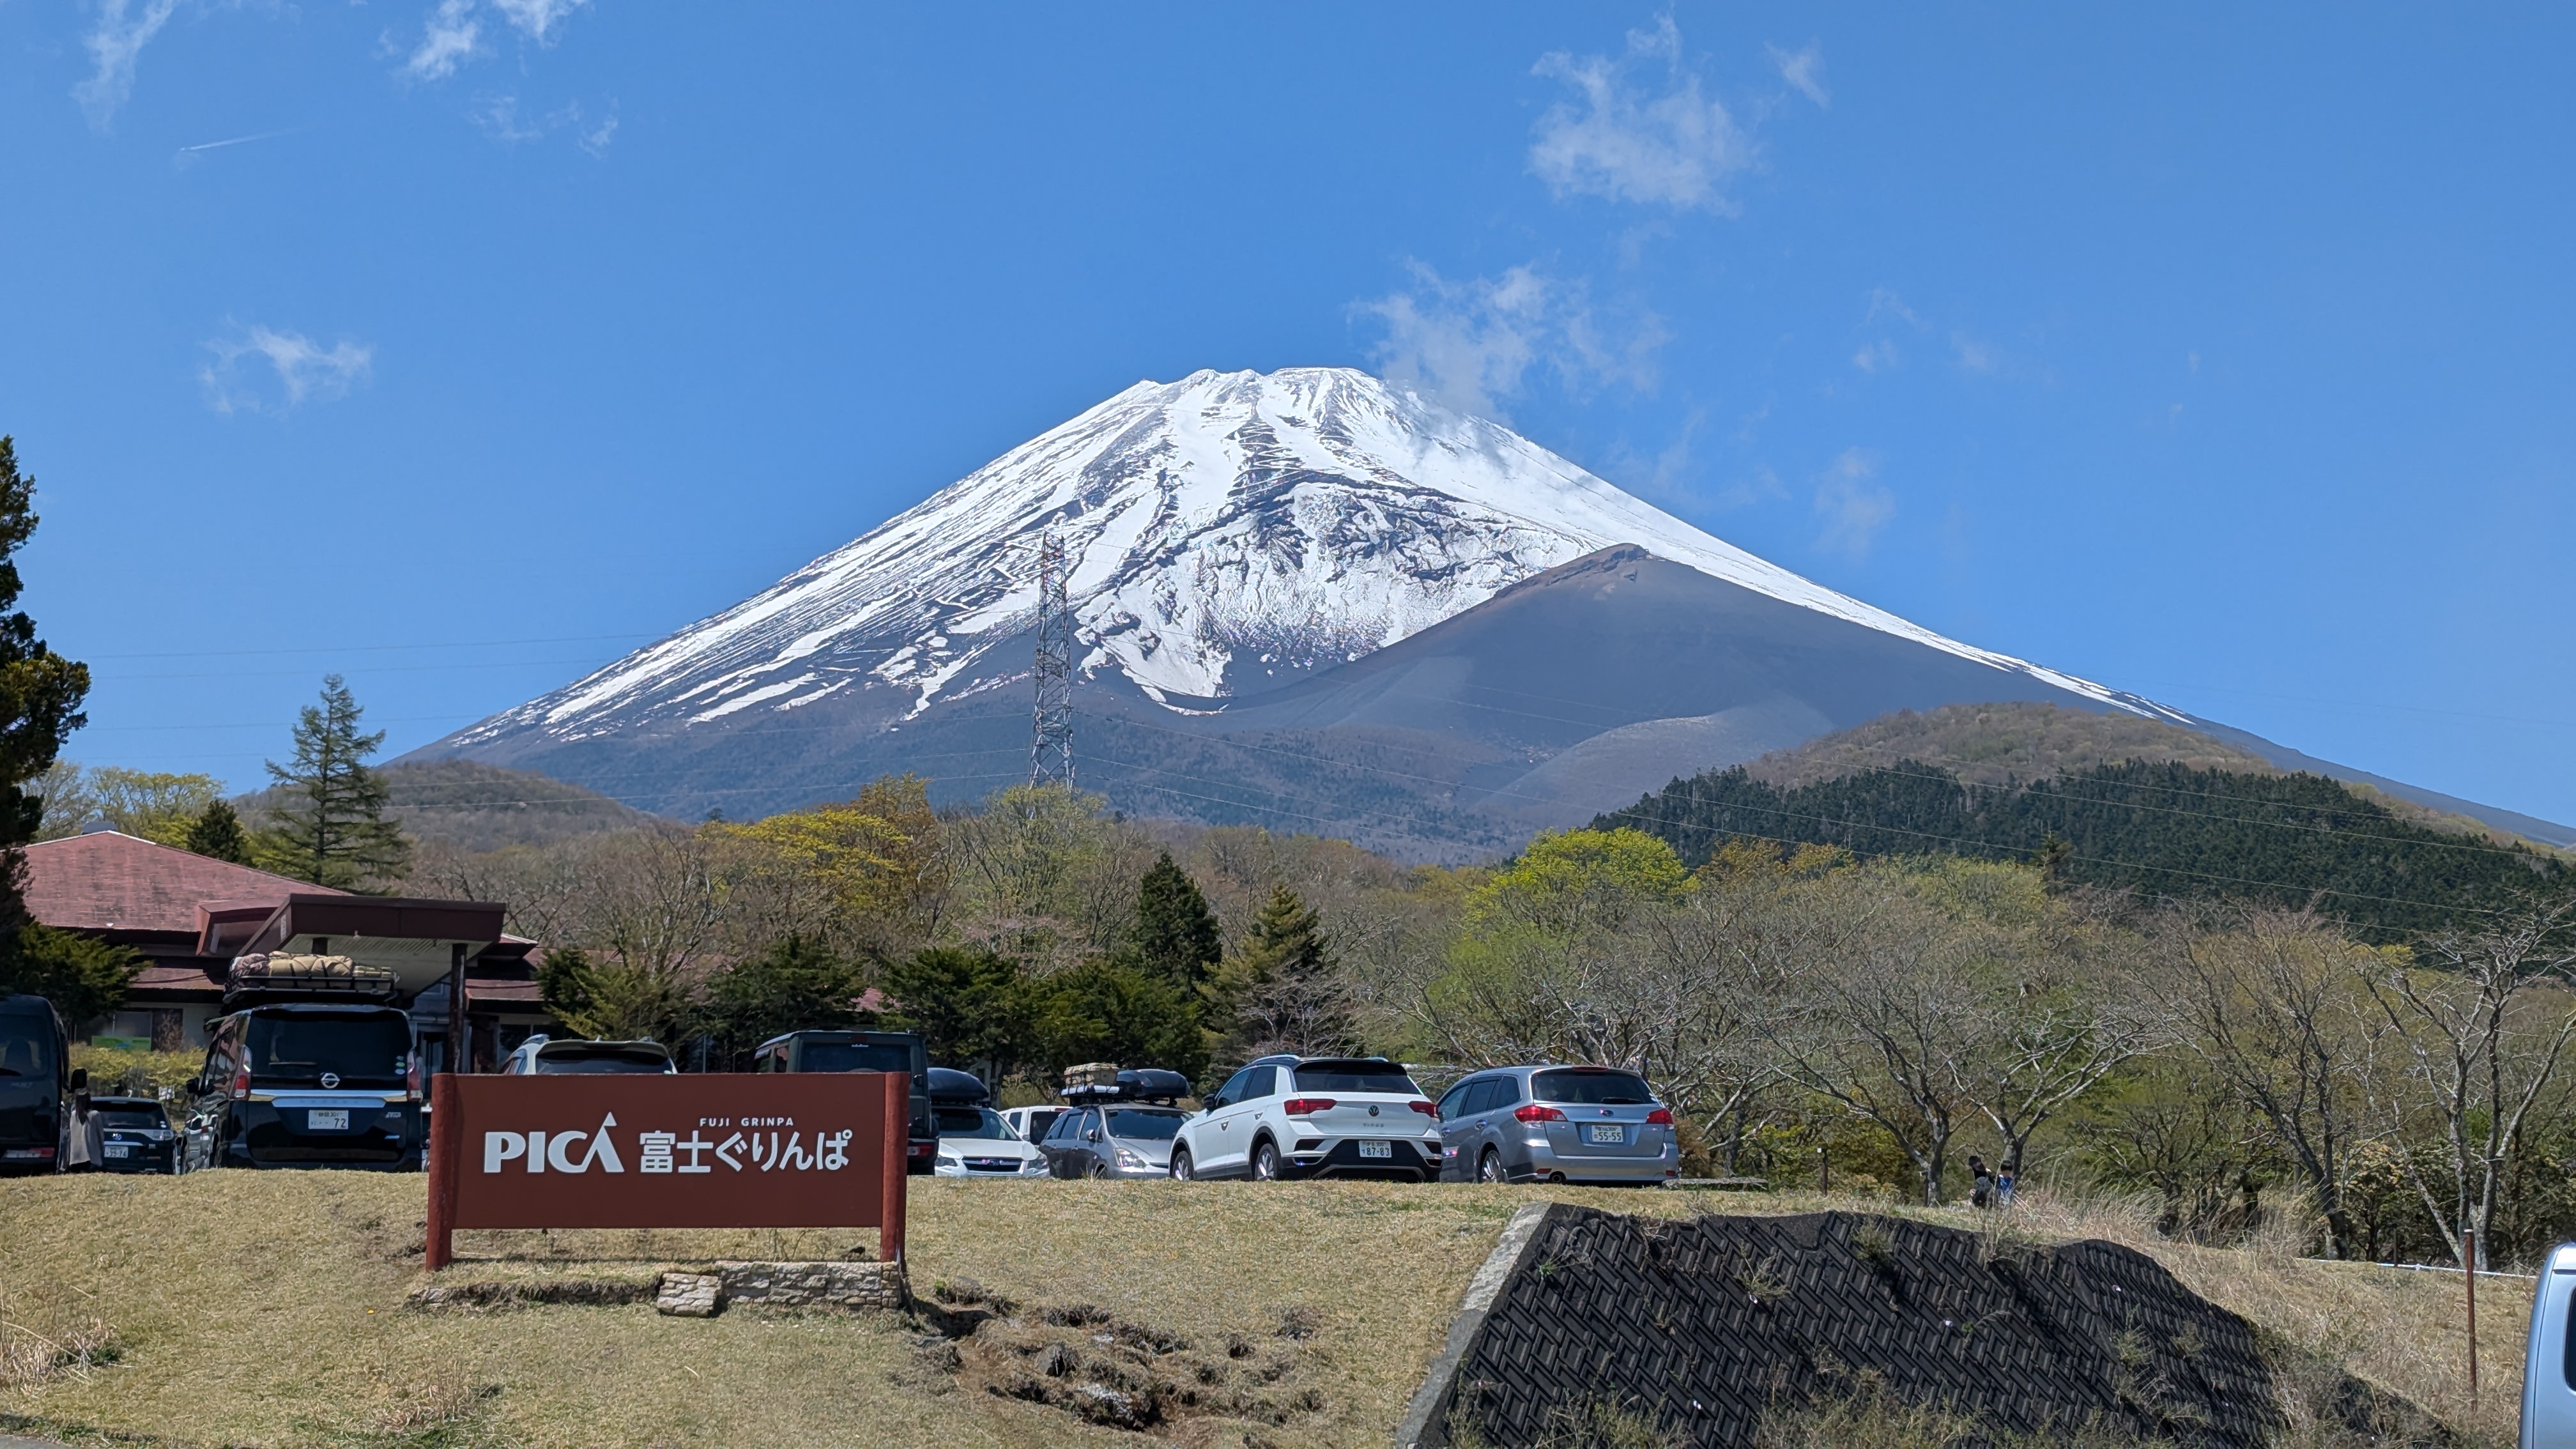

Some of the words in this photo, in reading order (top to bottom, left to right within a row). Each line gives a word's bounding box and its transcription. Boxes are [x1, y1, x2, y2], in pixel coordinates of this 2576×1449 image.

[700, 1117, 730, 1127] FUJI
[740, 1117, 793, 1126] GRINPA
[1598, 1132, 1621, 1141] 55-55
[640, 1129, 853, 1173] 富士ぐりんぱ
[1367, 1147, 1390, 1156] 87-83
